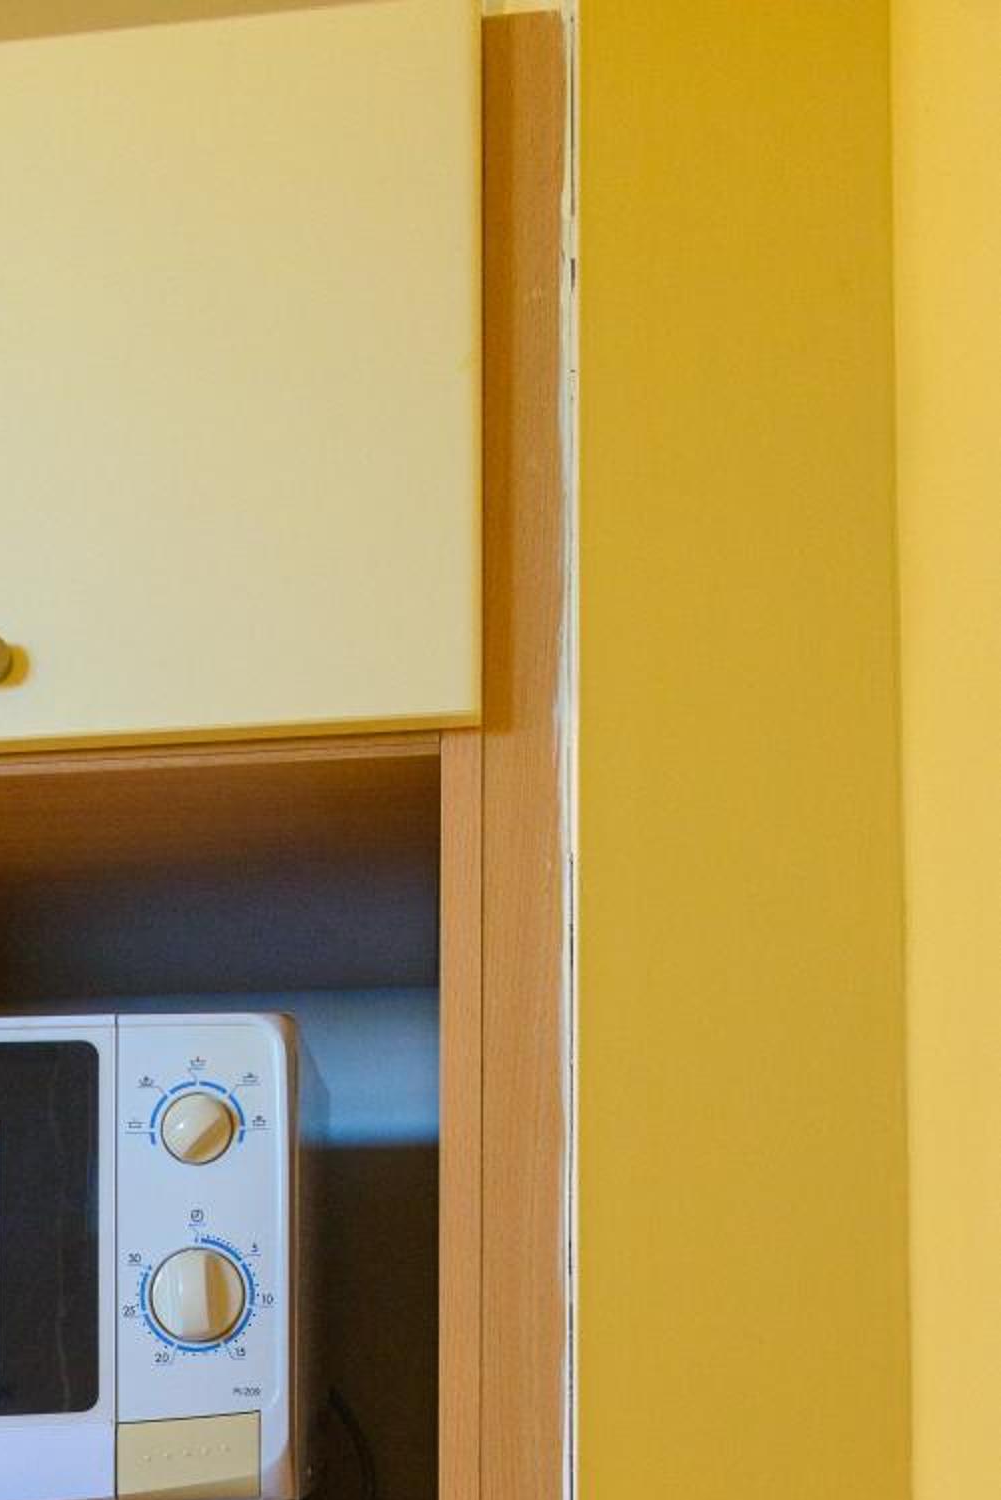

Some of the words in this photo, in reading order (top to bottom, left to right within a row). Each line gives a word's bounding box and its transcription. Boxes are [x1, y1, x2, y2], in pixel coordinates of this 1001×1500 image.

[127, 1253, 142, 1263] 30
[261, 1294, 274, 1305] 10
[123, 1305, 137, 1317] 25
[154, 1352, 170, 1363] 20
[235, 1348, 247, 1358] 15
